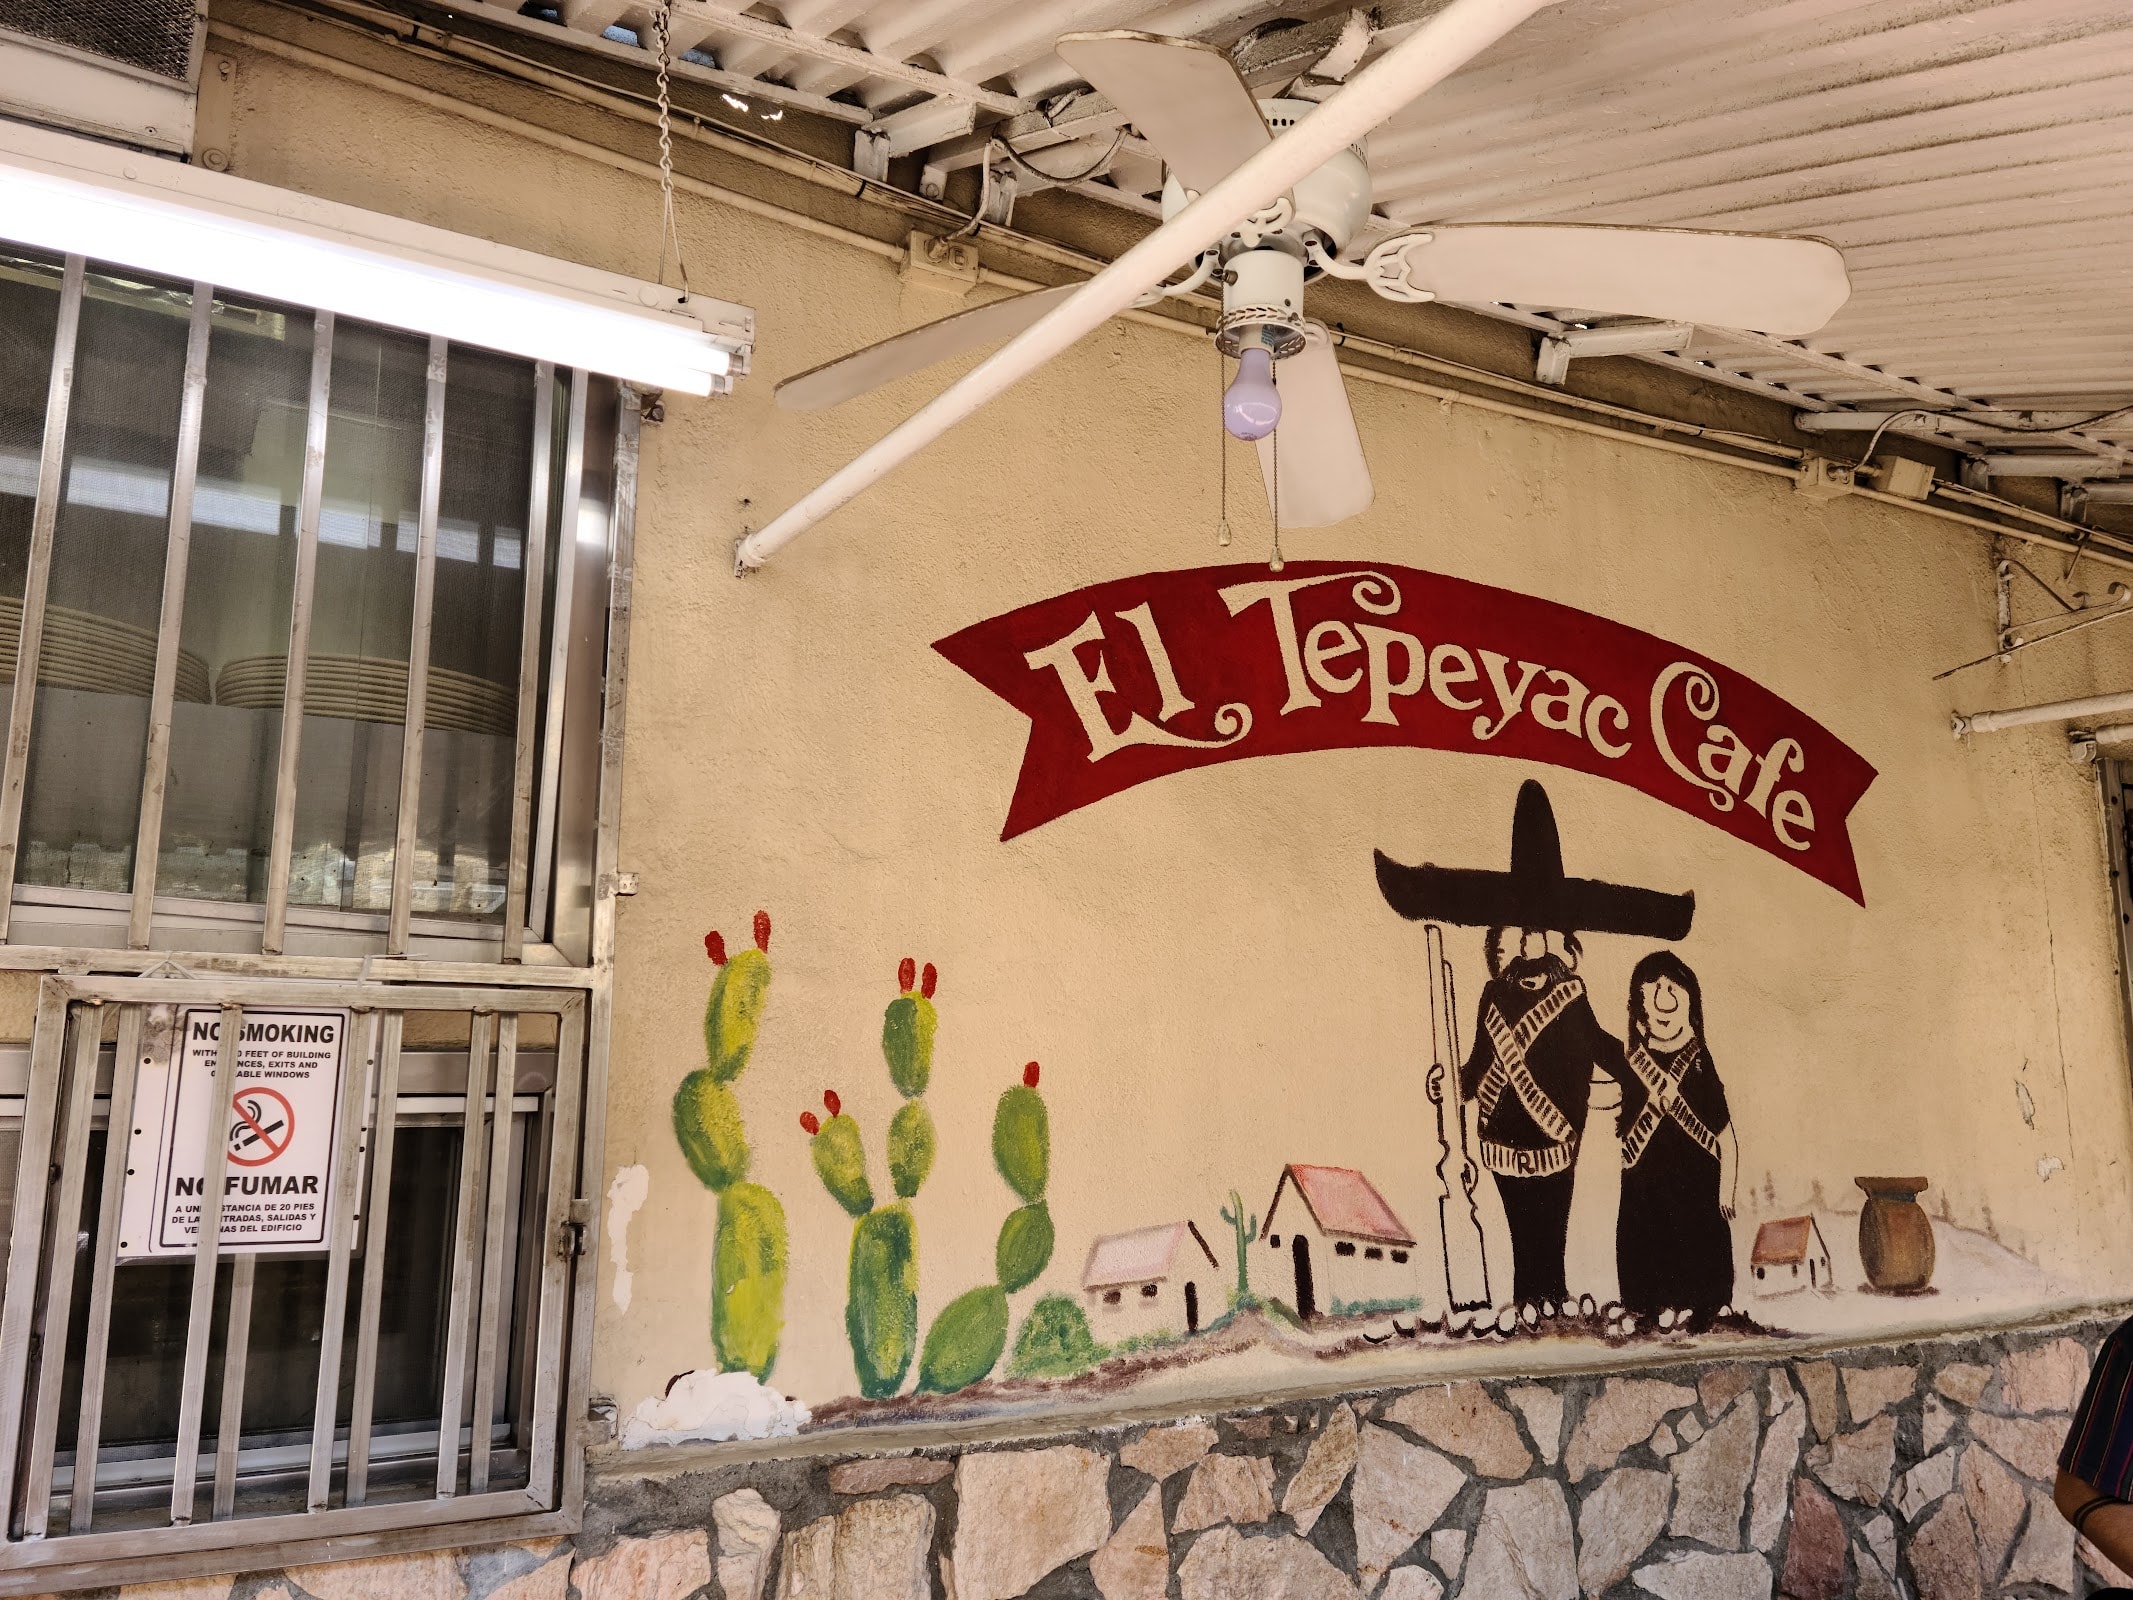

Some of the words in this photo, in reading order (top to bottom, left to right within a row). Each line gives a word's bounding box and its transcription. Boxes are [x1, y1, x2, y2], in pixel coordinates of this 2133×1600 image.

[1024, 602, 1252, 764] El
[1218, 571, 1632, 758] Tepeyac
[1651, 661, 1815, 851] Cafe
[193, 1022, 221, 1041] NO
[245, 1050, 269, 1058] FEET
[286, 1051, 331, 1059] BUILDING
[204, 1060, 265, 1069] ENNCES,
[268, 1061, 296, 1069] EXITS
[298, 1061, 318, 1069] AND
[211, 1070, 262, 1078] OABLE
[264, 1071, 310, 1079] WINDOWS
[224, 1176, 318, 1196] FUMAR
[175, 1205, 182, 1213] A
[185, 1205, 201, 1213] UN
[221, 1204, 261, 1212] STANCIA
[264, 1203, 277, 1211] DE
[279, 1203, 291, 1211] 20
[172, 1216, 185, 1224] DE
[187, 1215, 200, 1223] LA
[220, 1214, 264, 1223] TRADAS,
[267, 1213, 307, 1222] SALIDAS
[310, 1213, 316, 1221] Y
[239, 1225, 258, 1233] DEL
[260, 1224, 303, 1232] EDIFICIO
